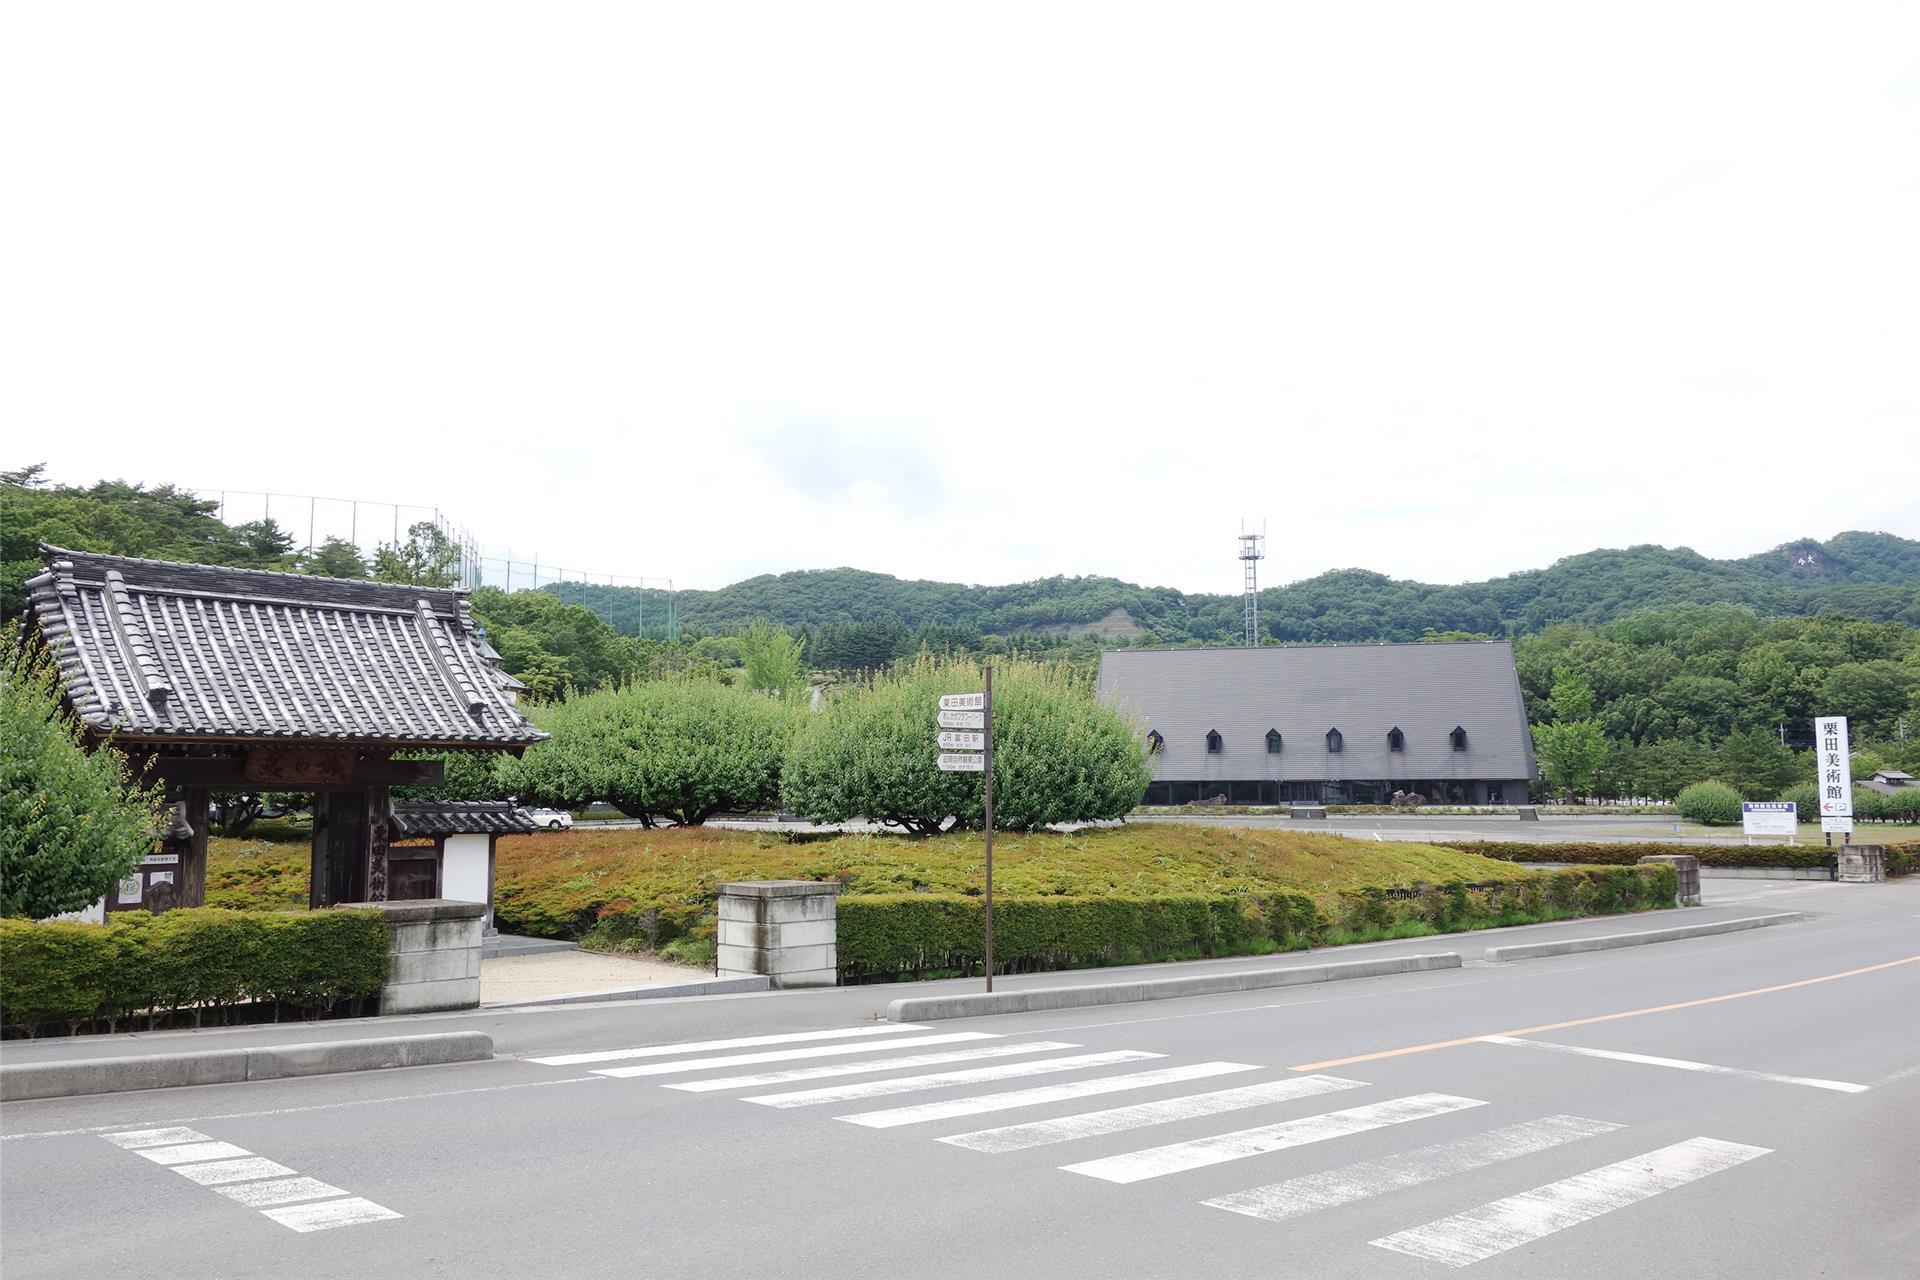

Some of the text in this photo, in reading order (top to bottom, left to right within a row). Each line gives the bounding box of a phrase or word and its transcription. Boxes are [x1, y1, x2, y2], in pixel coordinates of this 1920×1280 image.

[943, 696, 982, 707] 栗田美術館
[1823, 722, 1843, 799] 栗田美術館
